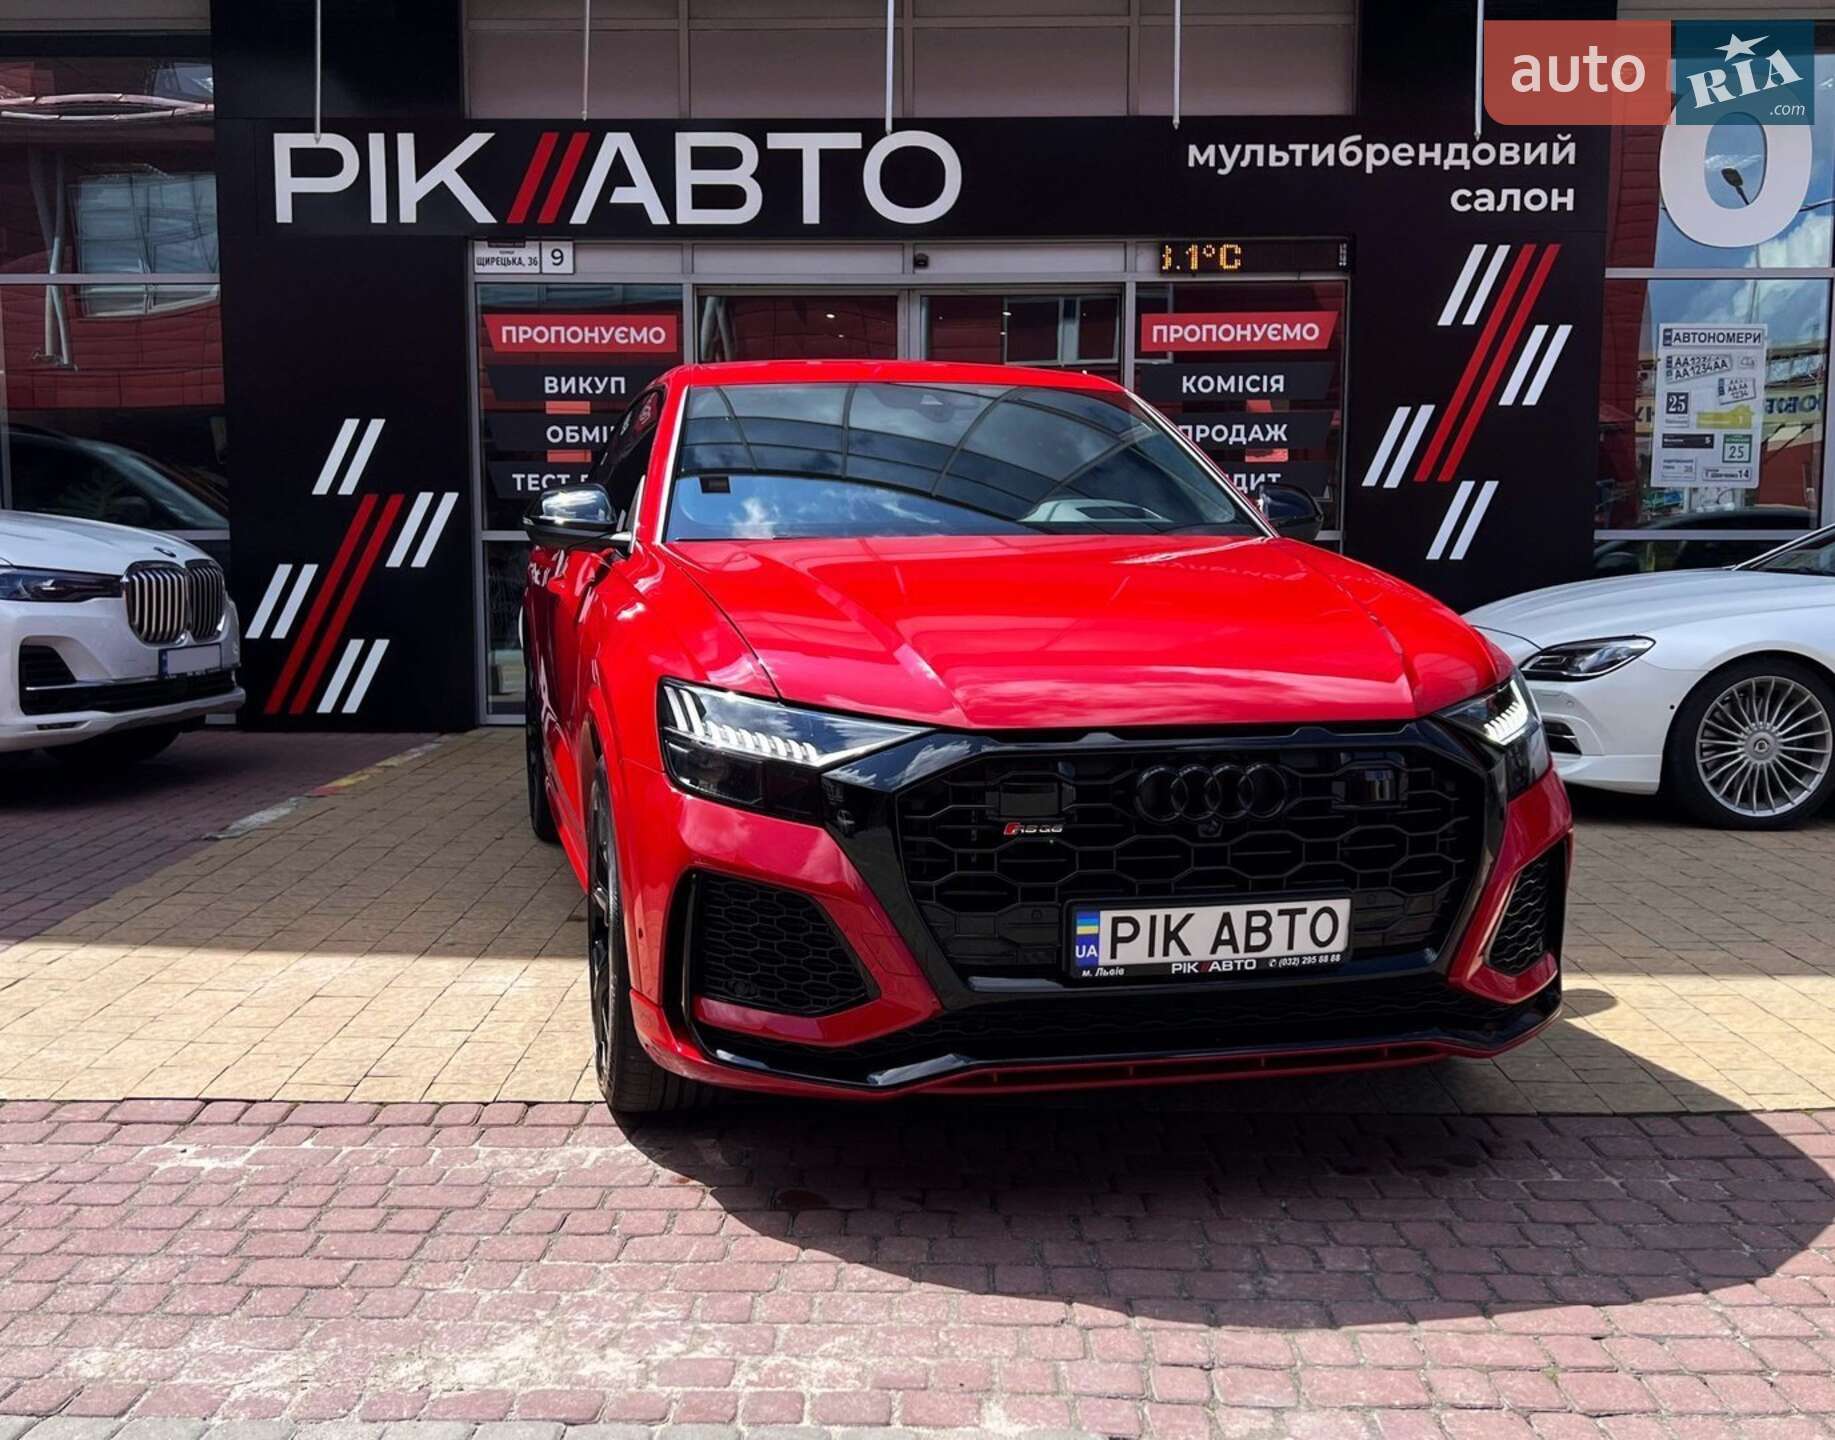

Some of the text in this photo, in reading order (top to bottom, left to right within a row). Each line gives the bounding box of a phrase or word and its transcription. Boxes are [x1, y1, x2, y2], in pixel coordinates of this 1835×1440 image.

[1187, 132, 1577, 176] мультибрендовий
[1449, 187, 1575, 212] салон
[527, 256, 538, 266] 36
[550, 248, 564, 266] 9
[501, 325, 666, 344] ПРОПОНУЄМО
[1152, 323, 1320, 343] ПРОПОНУЄМО
[1673, 332, 1761, 344] АВТОНОМЕРИ
[544, 376, 626, 394] ВИКУП
[1182, 375, 1285, 393] КОМІСІЯ
[1669, 395, 1686, 412] 25
[546, 425, 614, 443] ОБМІ
[1178, 424, 1288, 444] ПРОДАЖ
[1729, 445, 1745, 459] 25
[1075, 945, 1098, 958] UA
